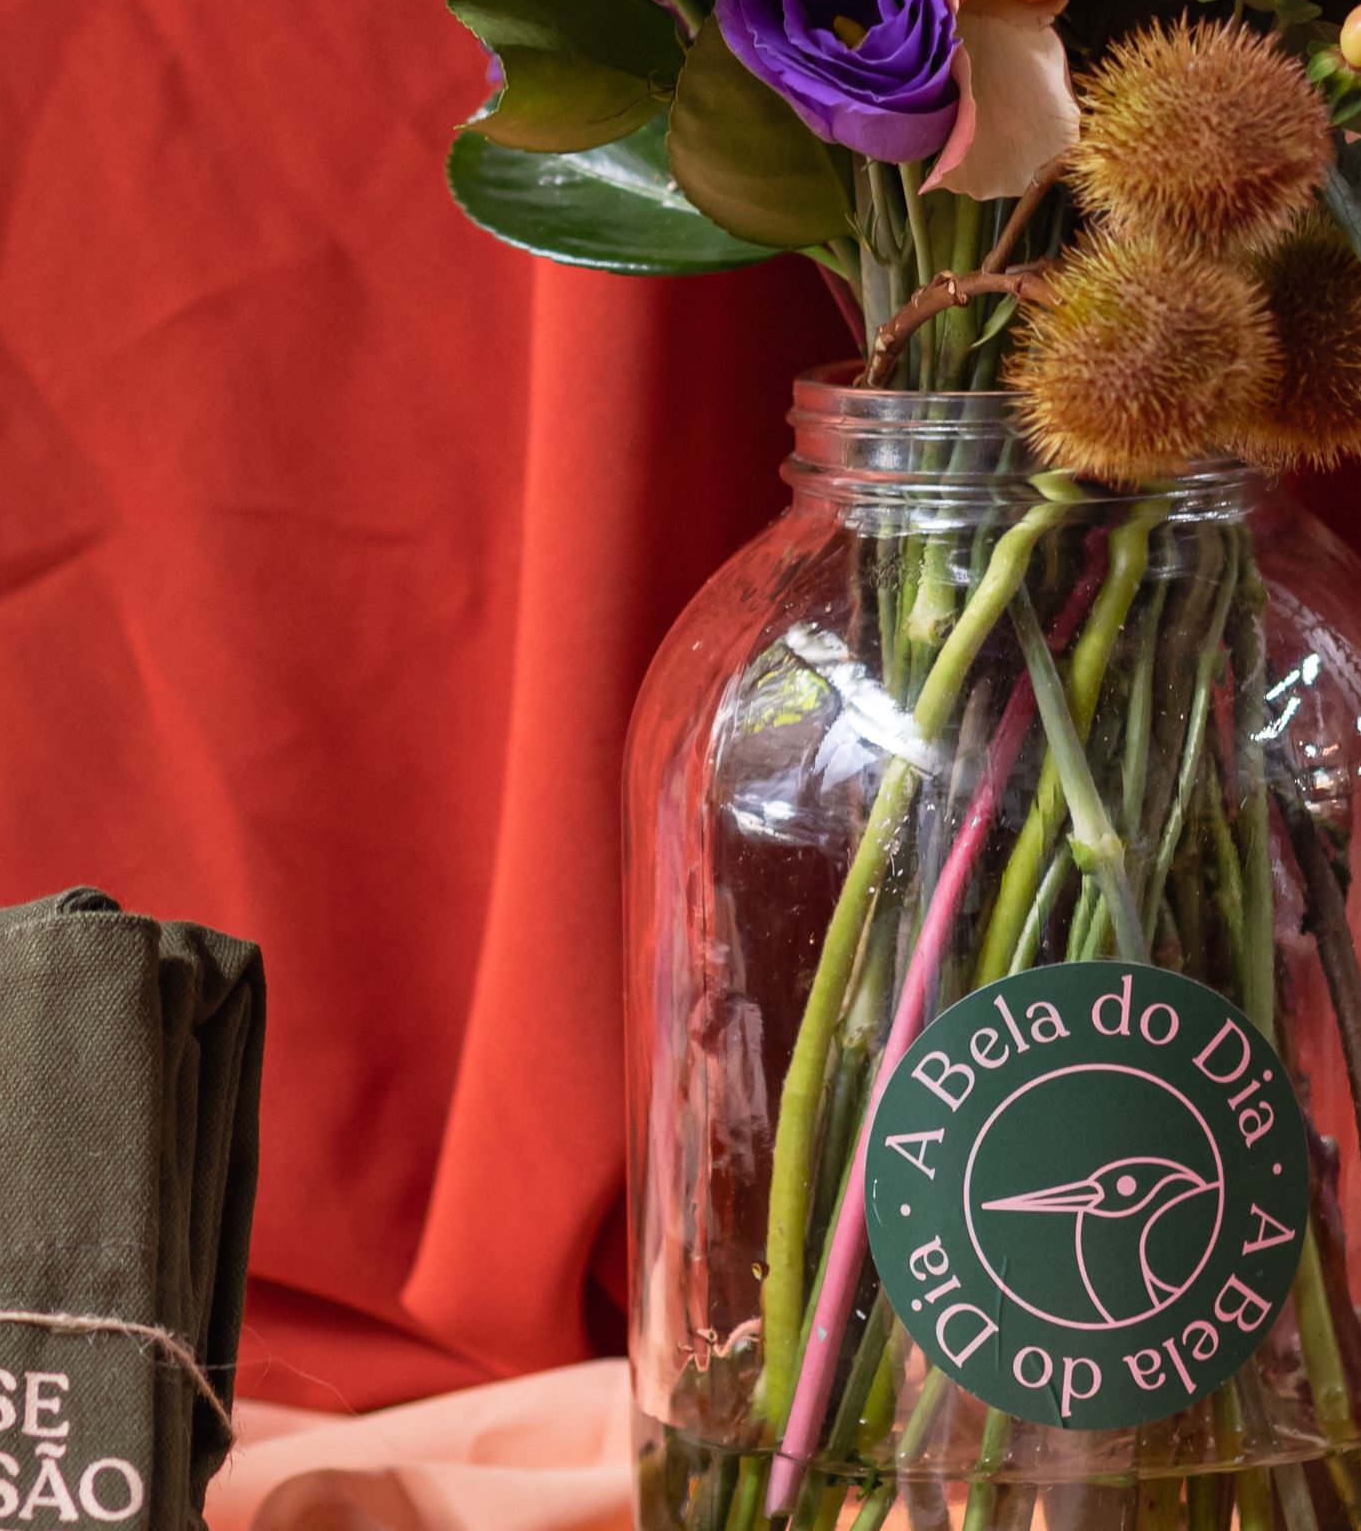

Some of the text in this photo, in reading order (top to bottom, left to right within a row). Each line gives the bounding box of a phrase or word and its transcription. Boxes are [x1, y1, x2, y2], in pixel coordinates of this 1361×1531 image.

[885, 974, 1275, 1180] A Bela do Dia
[909, 1203, 1296, 1418] A Bela do Dia
